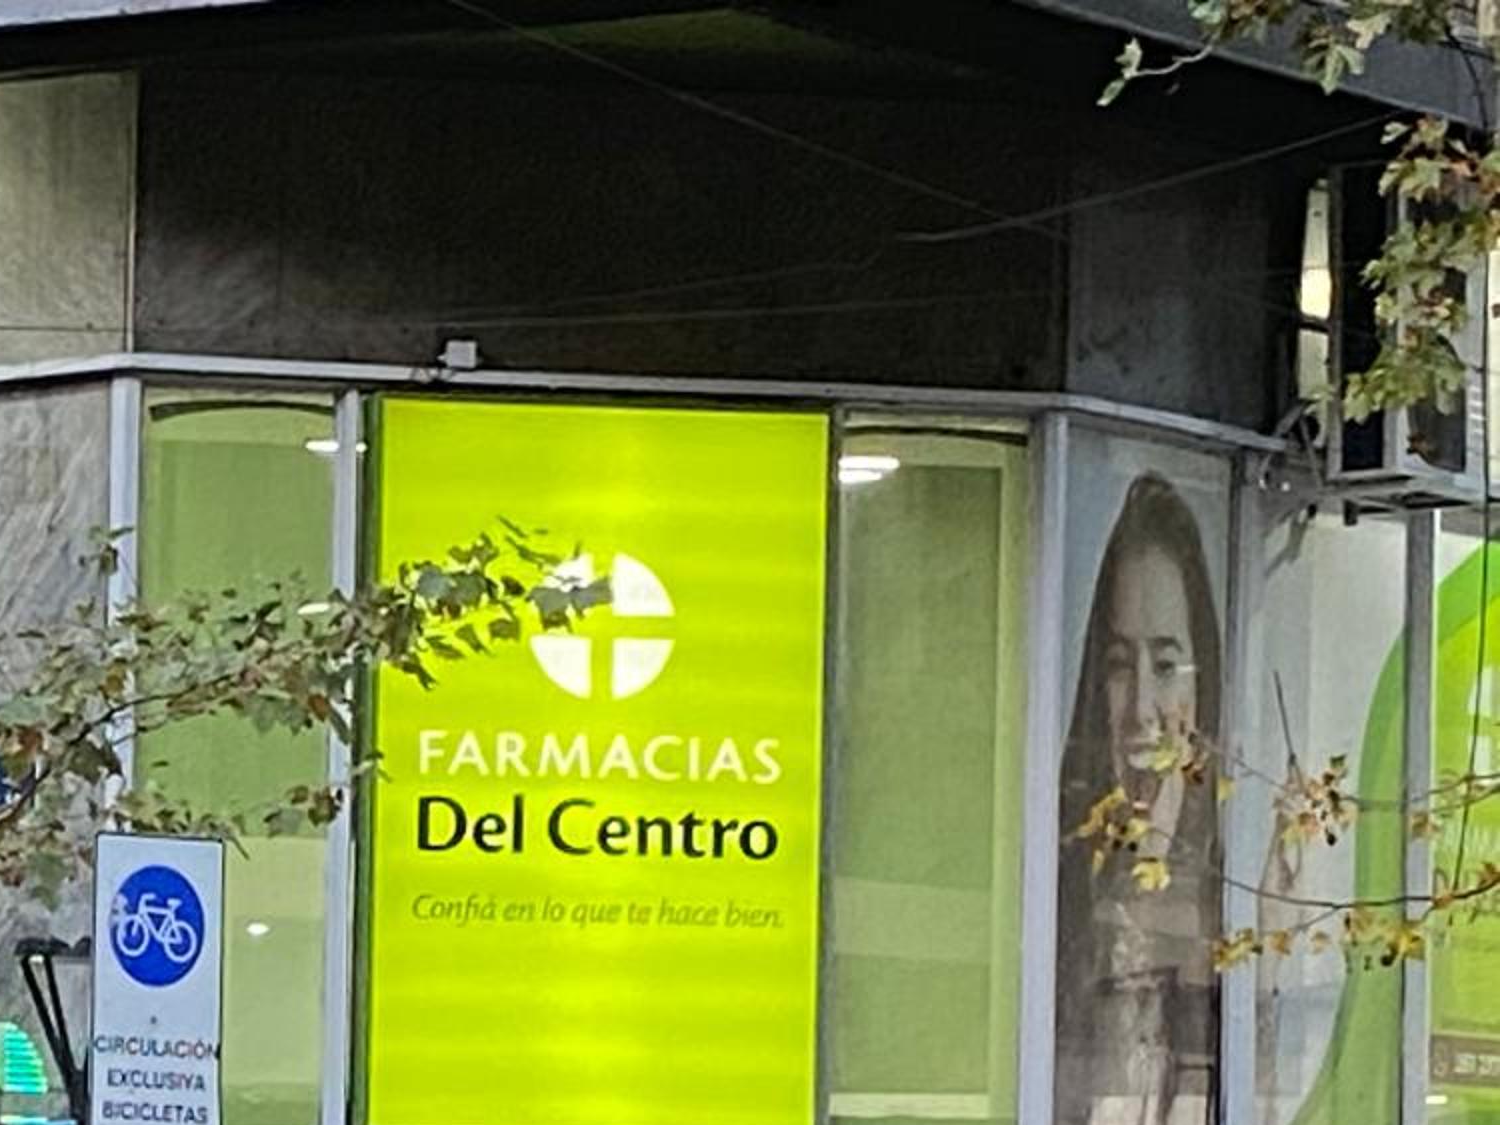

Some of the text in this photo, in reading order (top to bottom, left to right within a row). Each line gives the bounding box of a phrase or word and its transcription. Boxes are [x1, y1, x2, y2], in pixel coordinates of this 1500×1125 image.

[417, 729, 783, 785] FARMACIAS
[416, 793, 779, 861] Del Centro
[411, 893, 496, 928] Confiá
[502, 903, 534, 922] en
[541, 895, 566, 923] lo
[571, 904, 622, 929] que
[627, 901, 651, 925] te
[657, 898, 719, 927] hace
[107, 1068, 206, 1091] EXCLUSIVA
[102, 1101, 209, 1125] BICICLETAS
